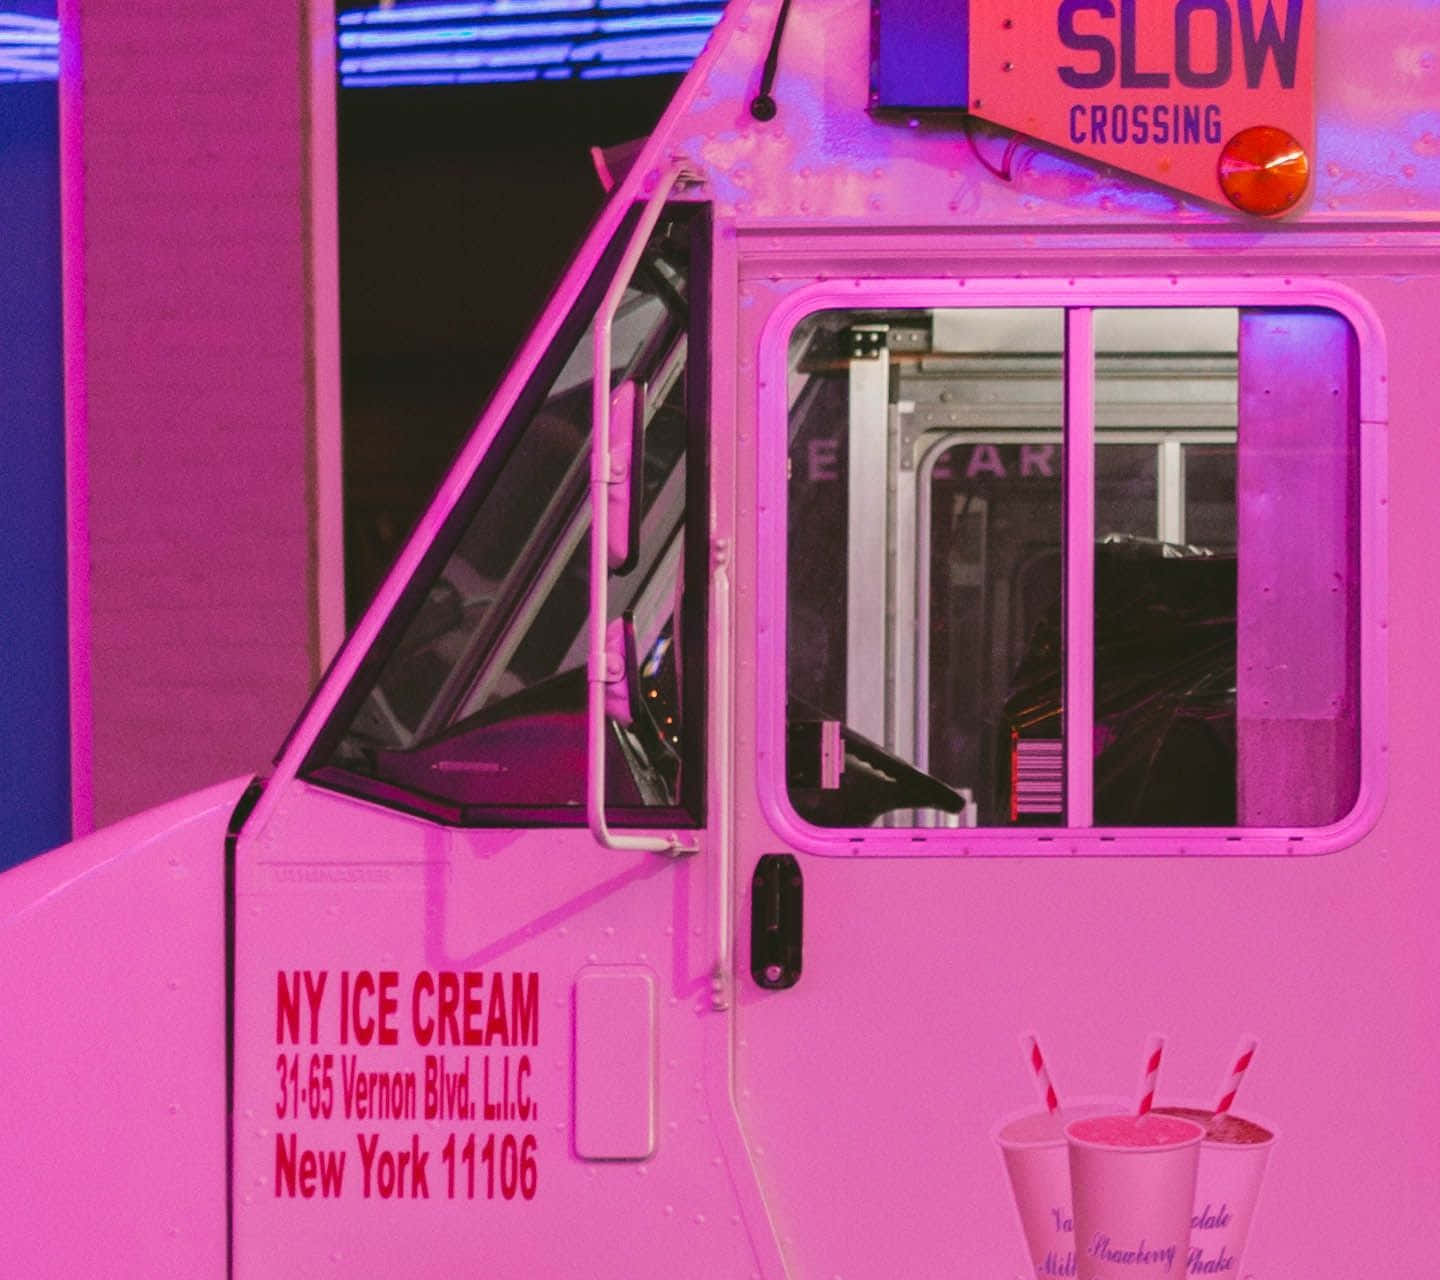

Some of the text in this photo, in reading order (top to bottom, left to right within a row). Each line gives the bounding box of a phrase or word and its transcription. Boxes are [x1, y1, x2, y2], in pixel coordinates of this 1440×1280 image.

[1069, 104, 1222, 145] CROSSING
[275, 970, 539, 1047] NY ICE CREAM
[275, 1053, 538, 1121] 31-65 Vernon Blvd. L.I.C.
[275, 1133, 538, 1200] New York 11106
[1087, 1231, 1177, 1272] Strawberry
